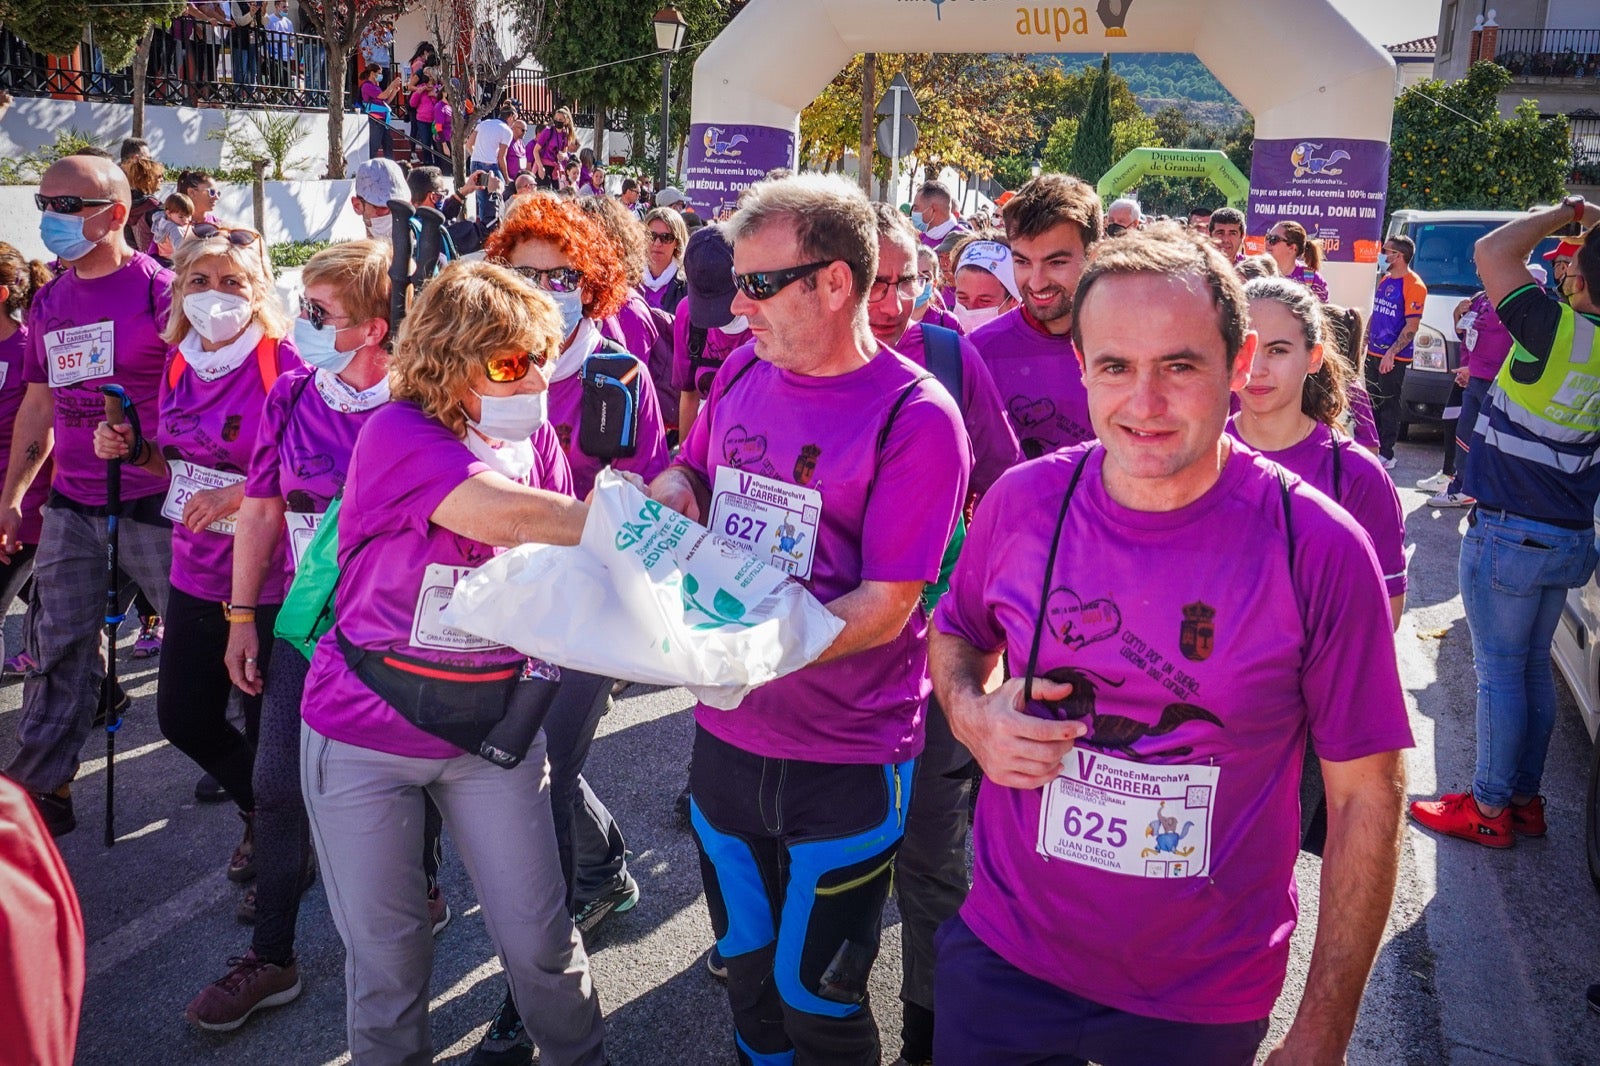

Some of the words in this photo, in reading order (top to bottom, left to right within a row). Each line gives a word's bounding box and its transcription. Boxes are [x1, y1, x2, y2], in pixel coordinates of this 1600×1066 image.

[1016, 7, 1089, 42] aupa
[1151, 151, 1207, 162] Diputación
[714, 166, 744, 176] leucemia
[1150, 162, 1161, 170] de
[1164, 162, 1206, 173] Granada
[1279, 188, 1305, 197] sueño,
[1307, 188, 1345, 198] leucemia
[1347, 190, 1366, 199] 100%
[1255, 203, 1276, 214] DONA
[1278, 202, 1324, 217] MÉDULA,
[1328, 206, 1357, 217] DONA
[1359, 207, 1377, 218] VIDA
[66, 333, 93, 343] CARRERA
[58, 352, 83, 370] 957
[750, 488, 789, 507] CARRERA
[725, 513, 768, 543] 627
[1077, 750, 1097, 782] V
[1096, 763, 1190, 783] #PonteEnMarchaYA
[1094, 773, 1162, 796] CARRERA
[1063, 805, 1127, 848] 625
[1053, 845, 1089, 861] DELGADO
[1090, 856, 1122, 869] MOLINA
[1058, 838, 1083, 852] JUAN
[1085, 845, 1116, 860] DIEGO
